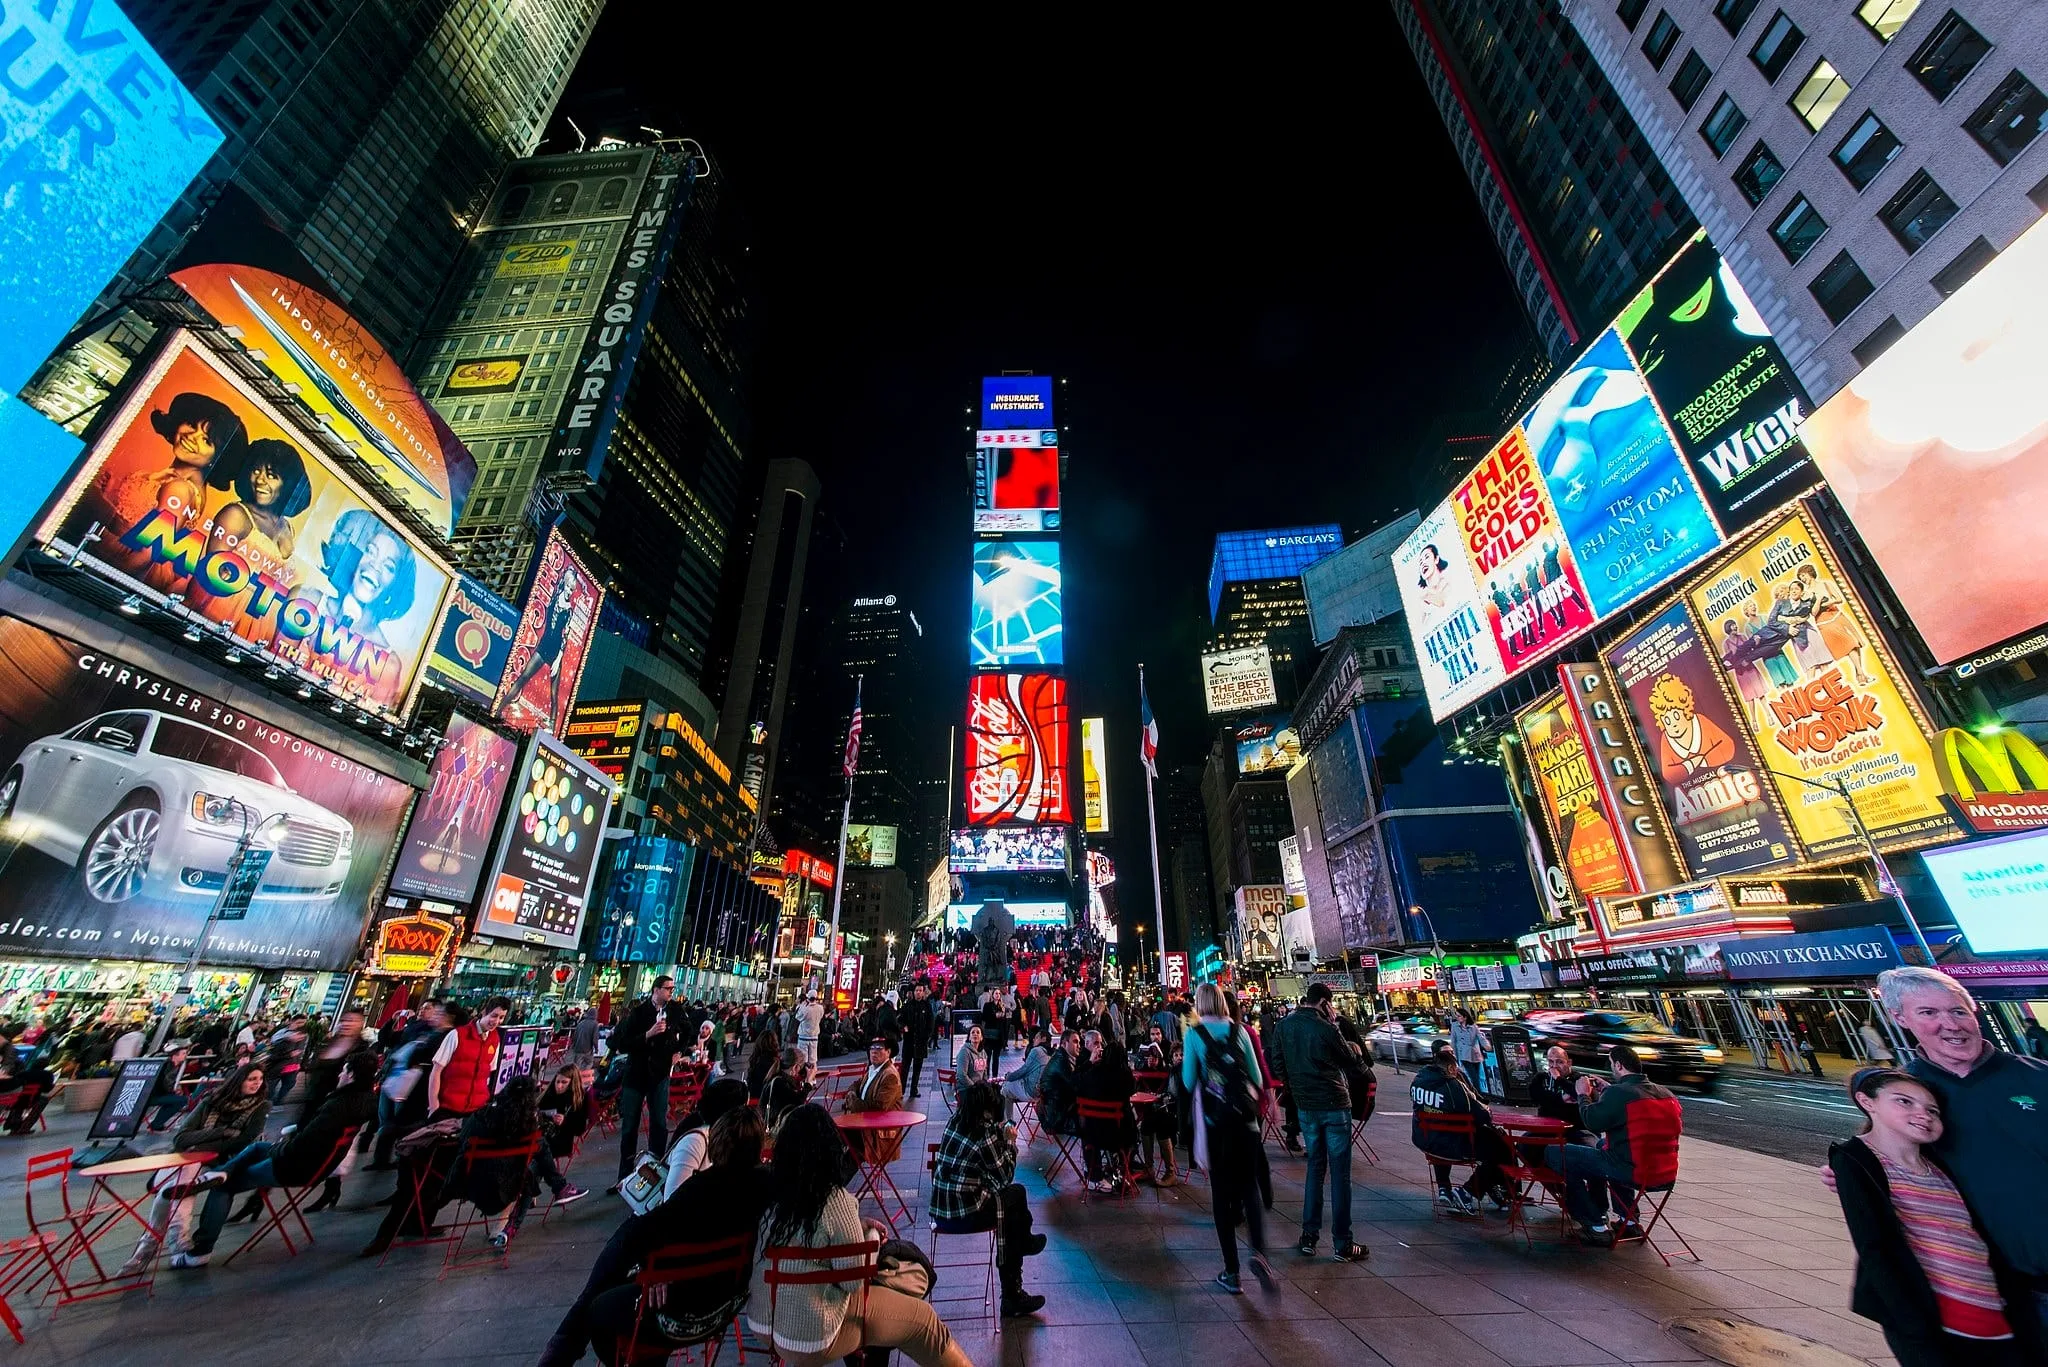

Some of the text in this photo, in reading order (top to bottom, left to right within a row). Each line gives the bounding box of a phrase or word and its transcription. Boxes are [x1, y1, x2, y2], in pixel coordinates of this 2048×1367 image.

[511, 244, 564, 264] Z100
[568, 174, 678, 429] TIMES SQUARE
[271, 287, 348, 370] IMPORTED
[351, 371, 385, 412] FROM
[990, 402, 1044, 410] INVESTMENTS
[995, 394, 1040, 402] INSURANCE
[1684, 380, 1739, 430] BIGGEST
[557, 447, 582, 457] NYC
[1454, 434, 1525, 514] THE
[1620, 457, 1649, 486] Musical
[1464, 463, 1530, 533] CROWD
[1606, 495, 1633, 517] The
[1470, 482, 1539, 554] GOES
[1580, 476, 1685, 561] PHANTOM
[167, 495, 295, 584] ON BROADWAY
[1279, 533, 1335, 546] BARCLAYS
[1605, 528, 1676, 581] OPERA
[1705, 543, 1811, 621] BRODERICK MUELLER
[1706, 537, 1792, 602] Matthew Jessie
[119, 508, 391, 685] MOTOWN
[853, 598, 884, 607] Allianz
[451, 589, 512, 640] Avenue
[1500, 599, 1541, 640] JERSEY
[455, 619, 491, 669] Q
[1654, 623, 1688, 650] MUSICAL
[1660, 641, 1676, 657] AND
[279, 640, 309, 667] THE
[1210, 672, 1268, 686] BEST MUSICAL
[1238, 678, 1268, 690] BEST
[1625, 670, 1648, 688] BETTER
[1648, 656, 1670, 672] THAN
[1212, 687, 1270, 702] MUSICAL OF
[1213, 699, 1231, 707] THIS
[1770, 670, 1854, 727] NICE
[78, 654, 384, 787] CHRYSLER 300 MOTOWN EDITION
[576, 705, 641, 715] THOMSON REUTERS
[1776, 694, 1884, 756] WORK
[1583, 675, 1656, 837] PALACE
[1800, 735, 1882, 772] If You Can Get It
[1824, 753, 1900, 782] Tony-Winning
[1550, 755, 1594, 798] HARD
[1682, 771, 1716, 789] THE MUSICAL
[1803, 791, 1825, 806] New
[1867, 763, 1916, 786] Comedy
[1558, 784, 1599, 817] BODY
[1675, 767, 1760, 825] Annie
[634, 863, 656, 871] Morgan
[1244, 887, 1285, 901] men
[1246, 902, 1255, 911] at
[1740, 887, 1788, 905] Annie
[1618, 909, 1642, 924] Annie
[1652, 902, 1678, 917] Annie
[130, 929, 321, 959] MotowTheMusical.com
[1728, 942, 1888, 967] MONEY EXCHANGE
[842, 955, 854, 990] tkts
[1167, 954, 1182, 988] tkts
[1558, 954, 1722, 980] Annie Annie
[1589, 955, 1658, 971] BOX OFFICE HERE
[1972, 965, 2000, 975] SQUARE
[2000, 964, 2039, 974] MUSEUM
[149, 971, 213, 994] SLM
